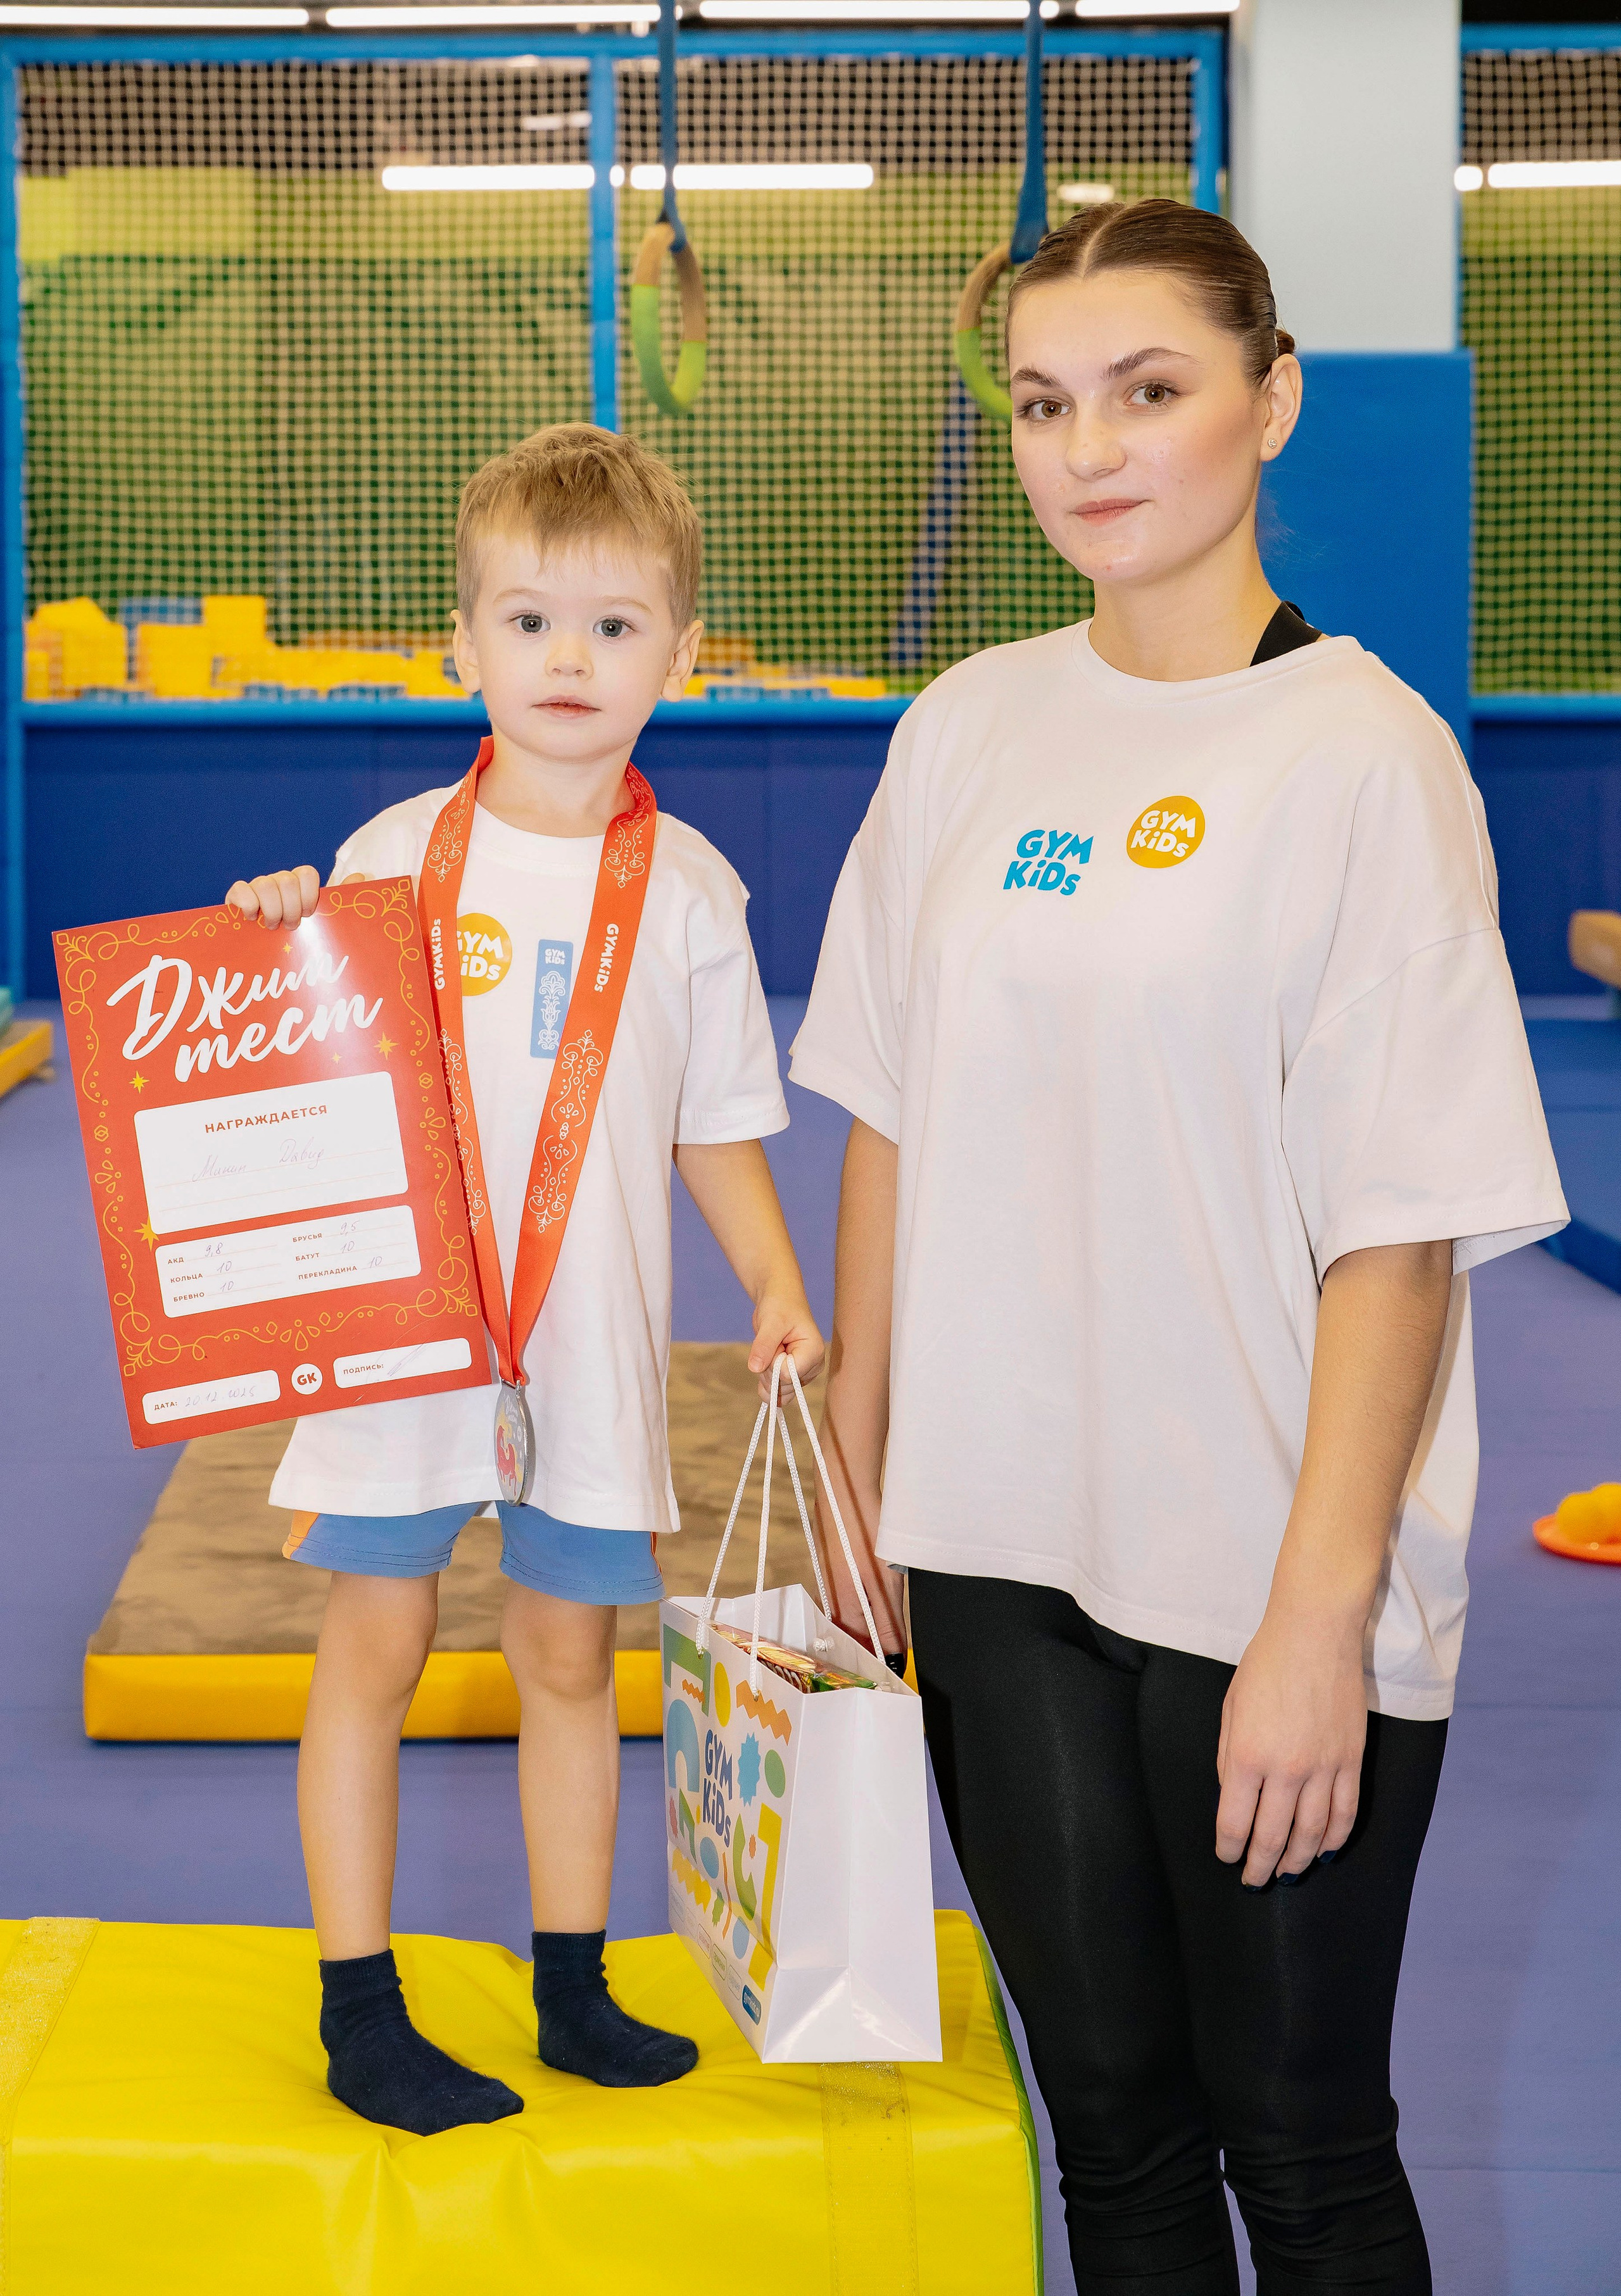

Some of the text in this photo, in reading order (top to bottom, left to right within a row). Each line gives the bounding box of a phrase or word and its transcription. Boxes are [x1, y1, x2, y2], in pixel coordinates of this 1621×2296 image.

[1140, 810, 1196, 838] GYM
[1016, 829, 1094, 865] GYM
[1130, 830, 1189, 858] KiDs
[1002, 859, 1082, 896] KiDs
[545, 948, 566, 959] GYM
[460, 954, 501, 981] iDs
[106, 953, 350, 1061] Джим
[174, 993, 384, 1083] тест
[205, 1105, 328, 1134] НАГРАЖДАЕТСЯ
[292, 1220, 360, 1243] БРУСЬЯ 9,5
[167, 1242, 224, 1265] АКД 9,8
[295, 1240, 355, 1262] БАТУТ 10
[170, 1260, 232, 1284] КОЛЬЦА 10
[298, 1256, 382, 1281] ПЕРЕКЛАДИНА 10
[173, 1281, 234, 1303] БРЕВНО 10
[297, 1372, 317, 1386] GK
[343, 1363, 384, 1375] ПОДПИСЬ:
[154, 1401, 178, 1411] ДАТА:
[705, 1729, 733, 1801] GYM
[702, 1778, 731, 1848] KiDs
